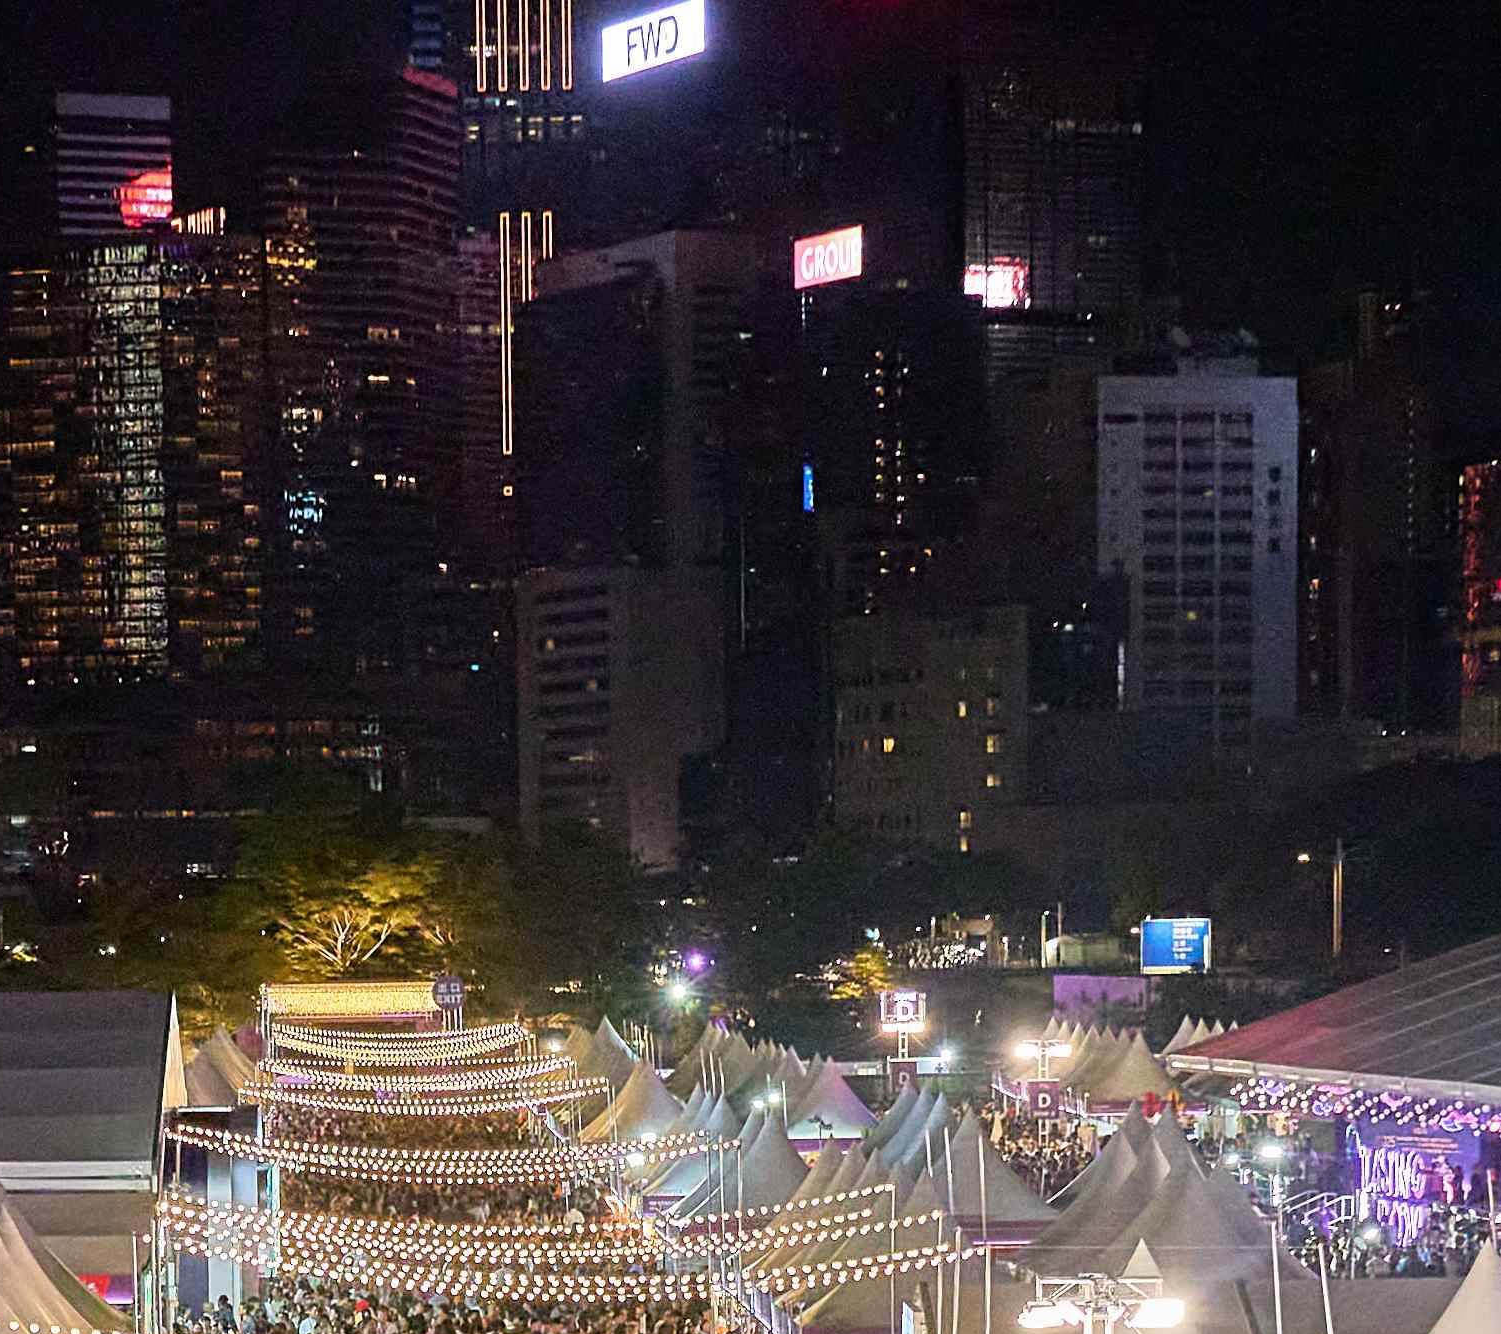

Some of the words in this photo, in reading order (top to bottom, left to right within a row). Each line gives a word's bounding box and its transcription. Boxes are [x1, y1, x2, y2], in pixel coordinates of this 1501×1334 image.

[627, 16, 678, 68] FWD
[436, 994, 463, 1004] EXIT
[1038, 1093, 1051, 1108] D
